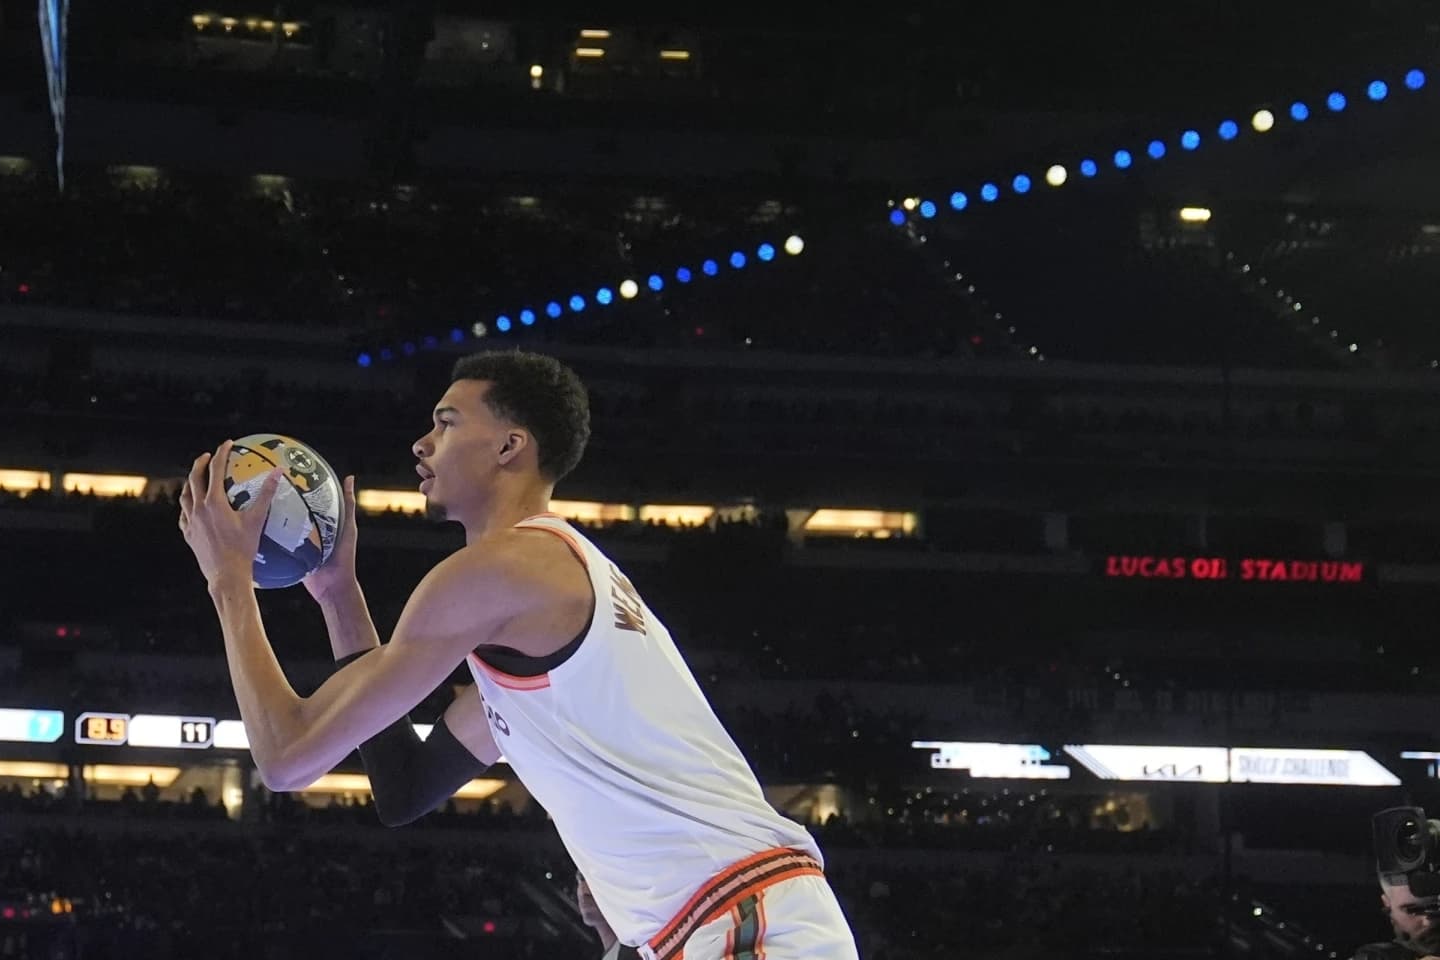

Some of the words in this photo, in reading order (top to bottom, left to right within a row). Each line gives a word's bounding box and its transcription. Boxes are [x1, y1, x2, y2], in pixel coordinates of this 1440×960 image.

[1106, 556, 1185, 578] LUCAS
[1240, 559, 1363, 582] STADIUM
[183, 723, 208, 743] 11
[1143, 766, 1202, 776] KIA
